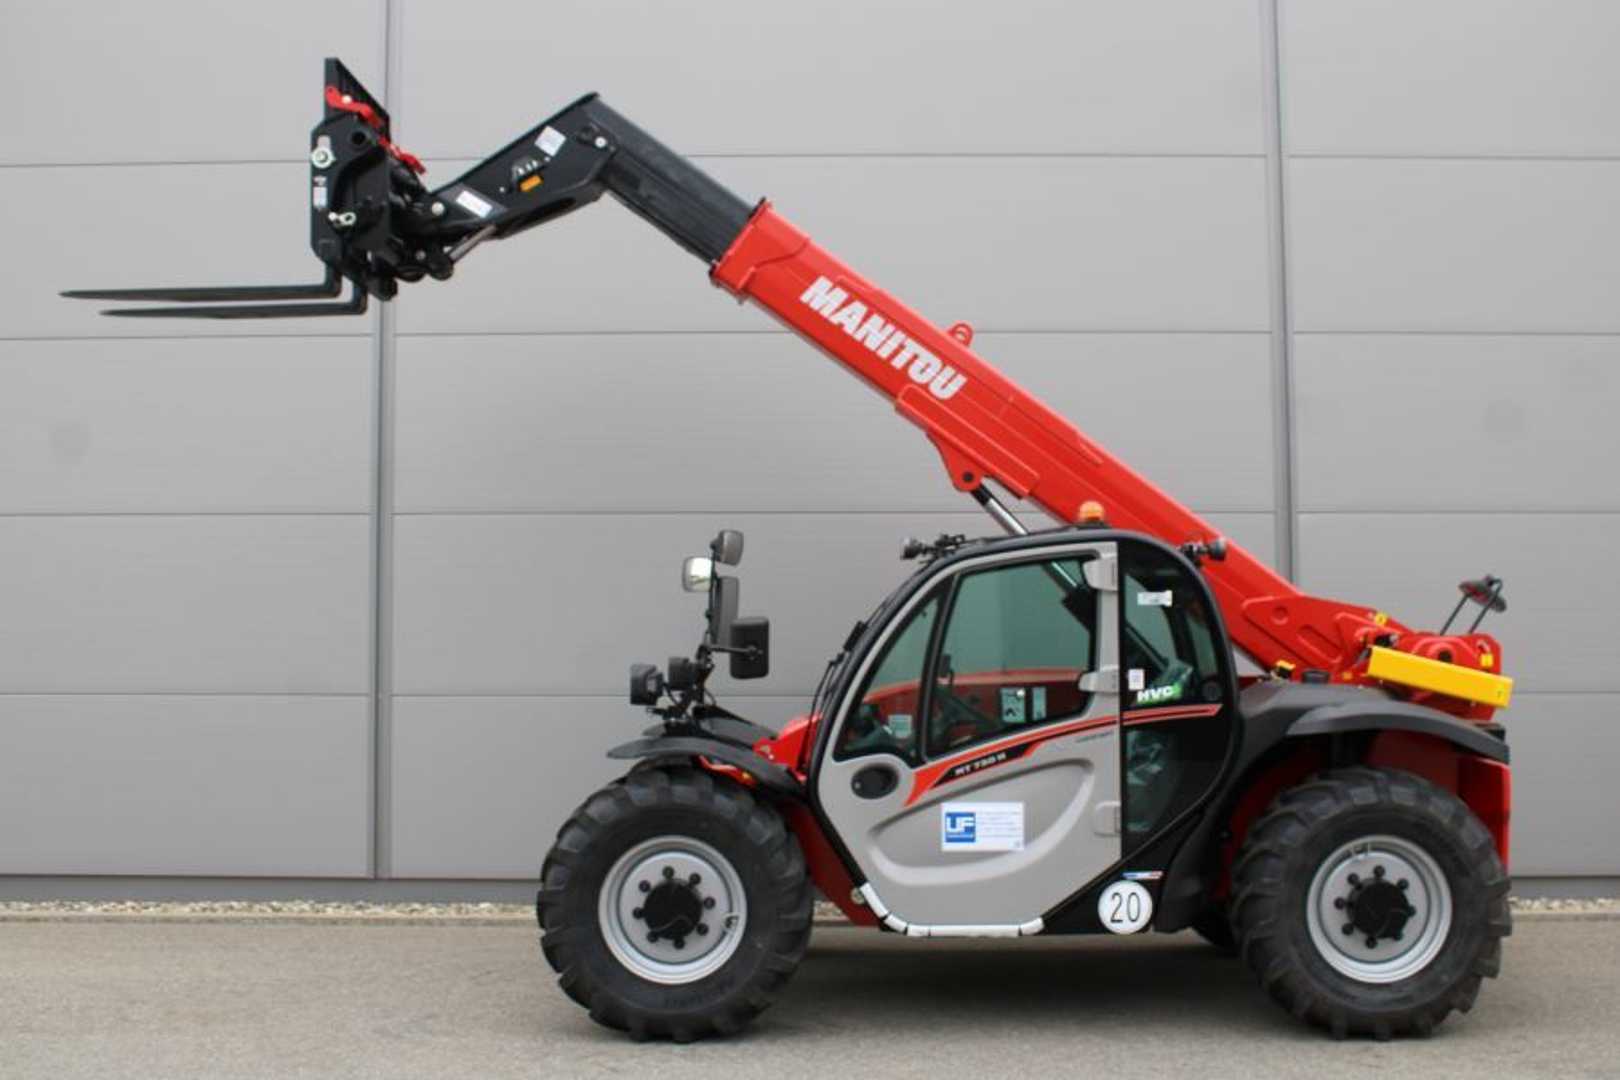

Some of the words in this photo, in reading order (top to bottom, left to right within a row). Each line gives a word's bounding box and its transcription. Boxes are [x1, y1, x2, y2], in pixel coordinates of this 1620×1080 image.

[800, 275, 967, 399] MANITOU
[945, 816, 975, 833] UF
[1110, 892, 1141, 923] 20
